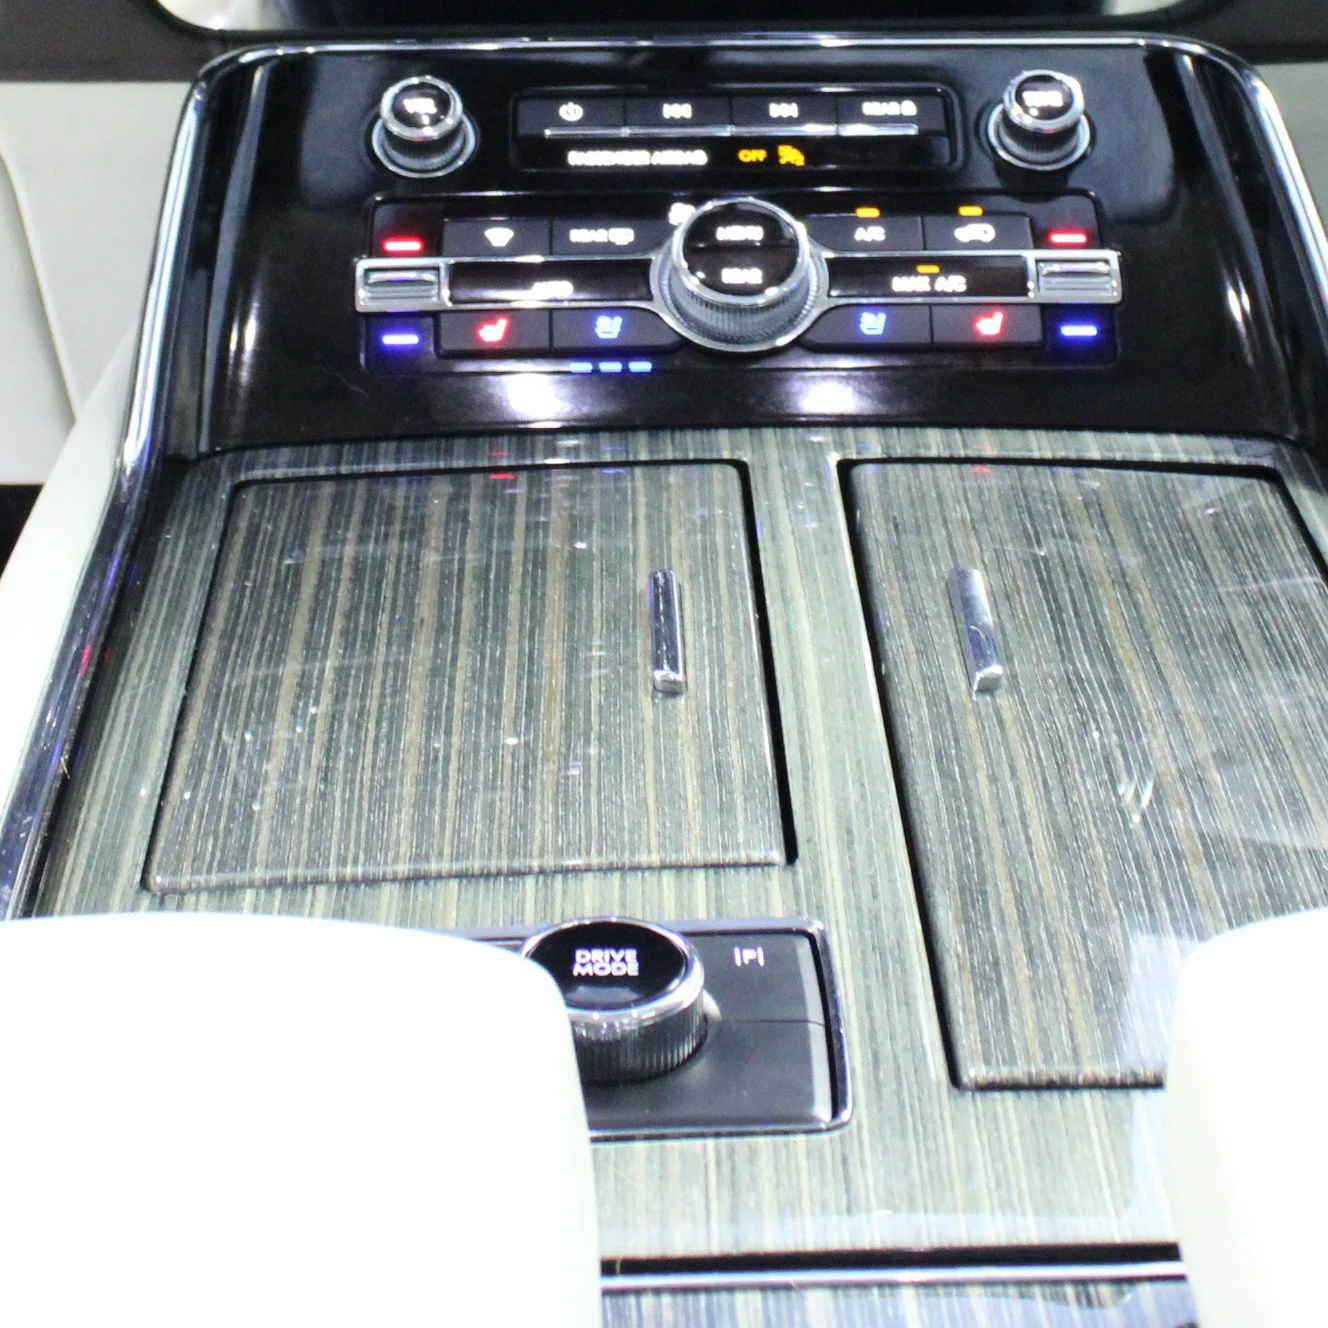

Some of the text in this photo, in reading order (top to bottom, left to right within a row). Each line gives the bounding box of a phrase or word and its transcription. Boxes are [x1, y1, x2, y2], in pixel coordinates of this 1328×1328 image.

[738, 149, 767, 162] OFF
[575, 949, 637, 962] DRIVE
[573, 962, 638, 976] MODE
